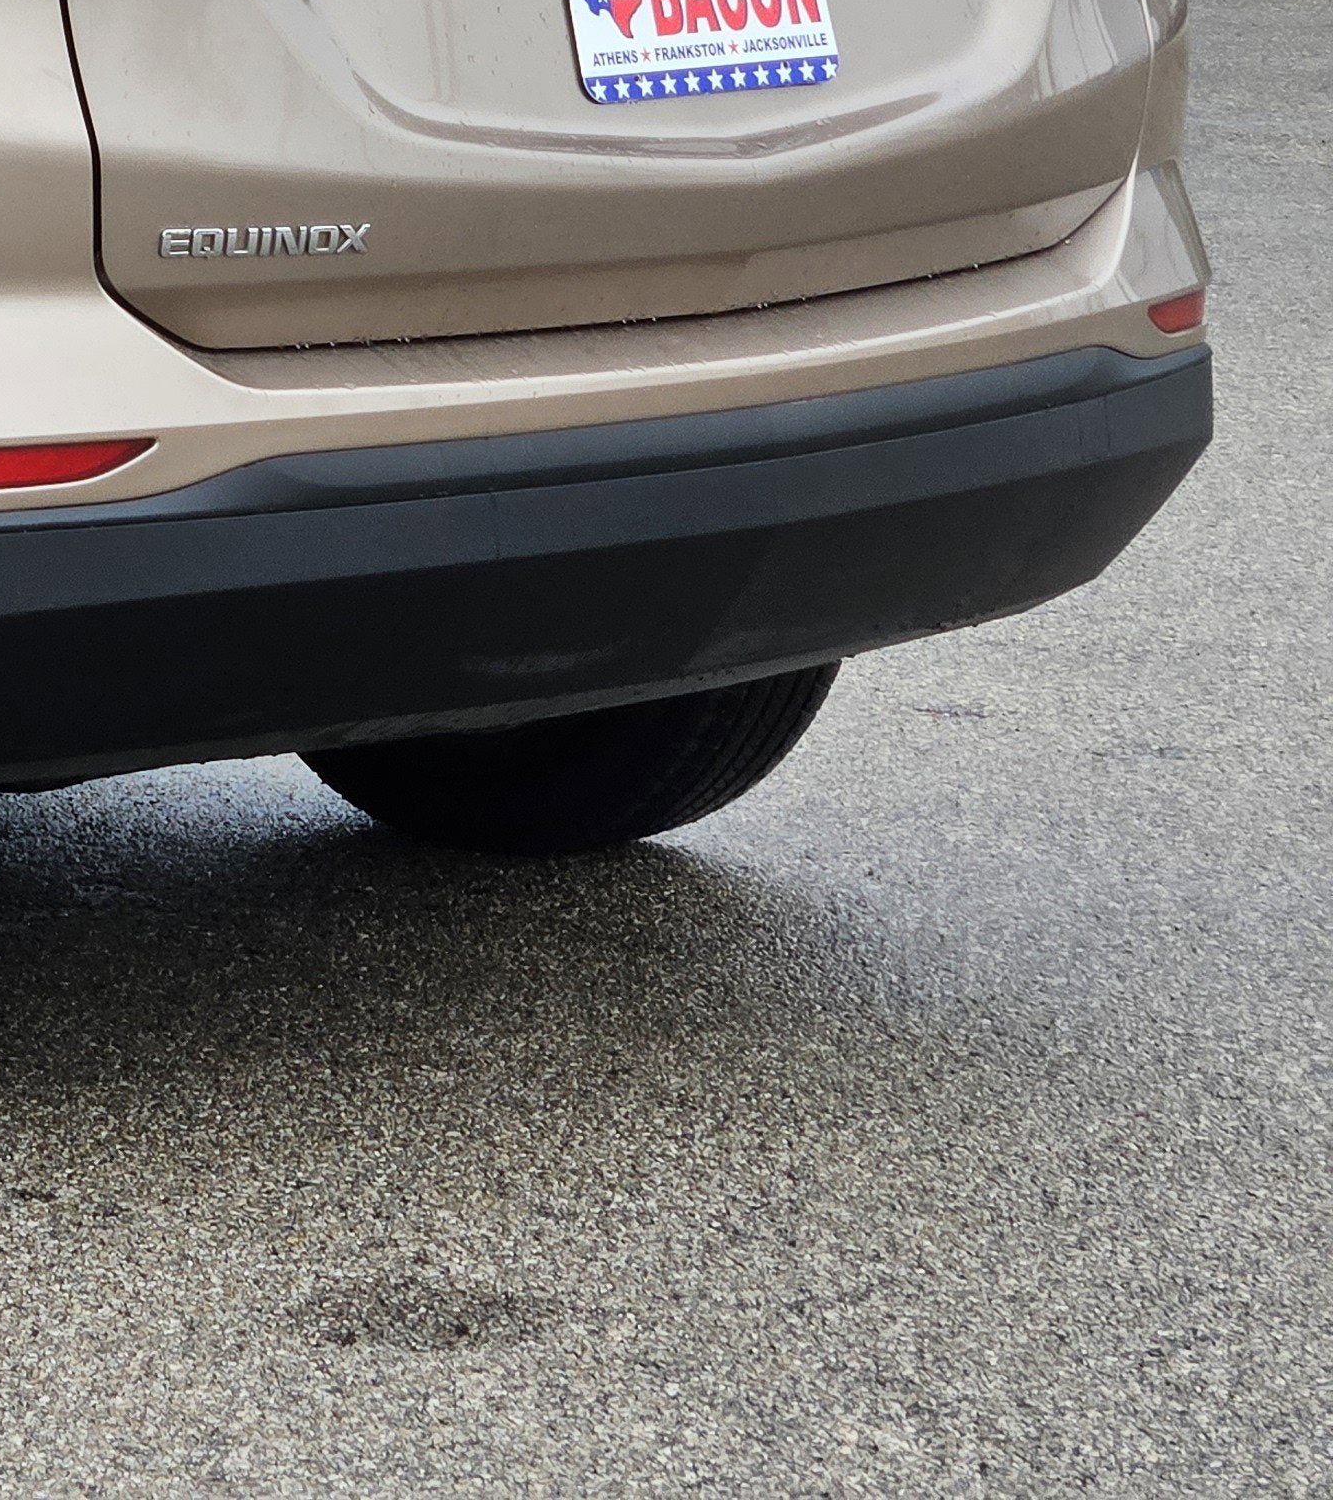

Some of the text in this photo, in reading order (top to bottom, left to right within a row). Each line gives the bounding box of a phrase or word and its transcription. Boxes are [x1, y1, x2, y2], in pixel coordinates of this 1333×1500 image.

[592, 33, 829, 67] ATHENS FRANKSTON JACKSONVILLE
[159, 223, 371, 259] EQUINOX
